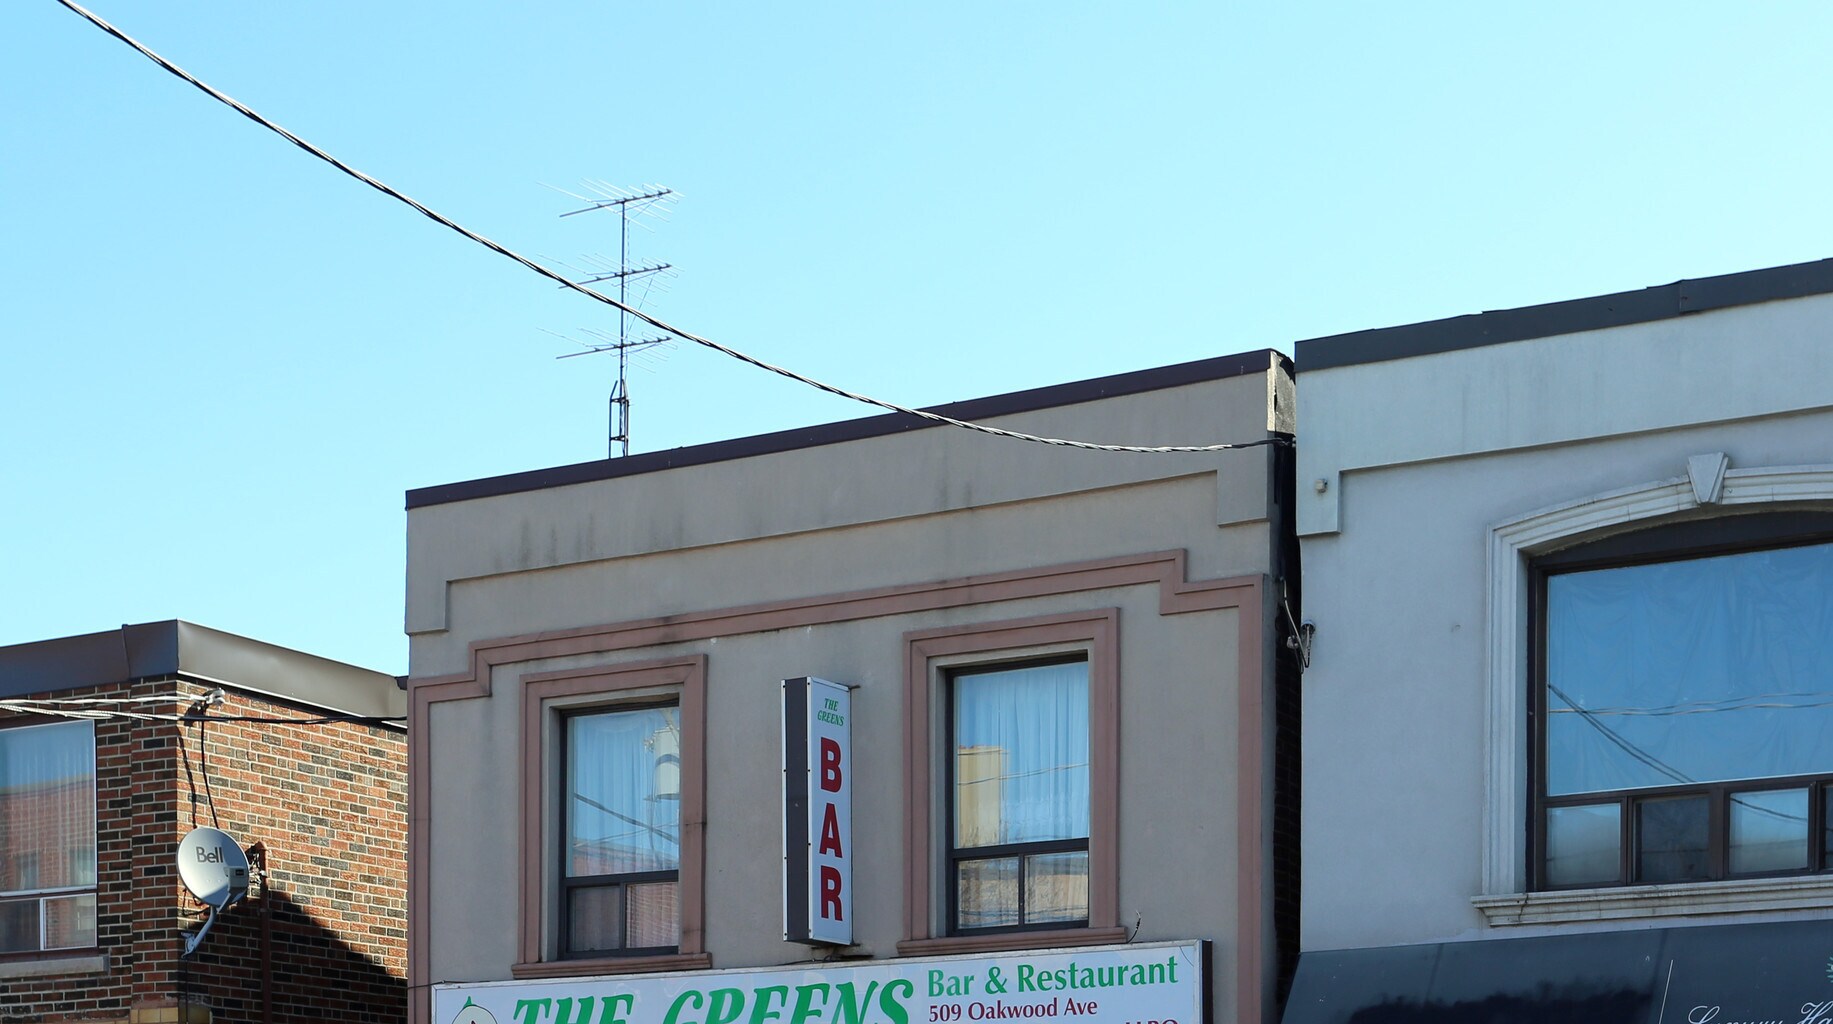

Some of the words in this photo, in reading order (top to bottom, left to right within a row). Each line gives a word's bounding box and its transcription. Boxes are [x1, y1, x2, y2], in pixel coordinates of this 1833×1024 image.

[824, 697, 838, 711] THE
[817, 709, 844, 726] GREENS
[819, 736, 843, 922] BAR
[195, 846, 224, 864] Bell
[928, 969, 974, 997] Bar
[985, 966, 1008, 995] &
[1017, 956, 1178, 992] Restaurant
[929, 1003, 961, 1022] 509
[967, 997, 1058, 1021] Oakwood
[1063, 998, 1098, 1016] Ave
